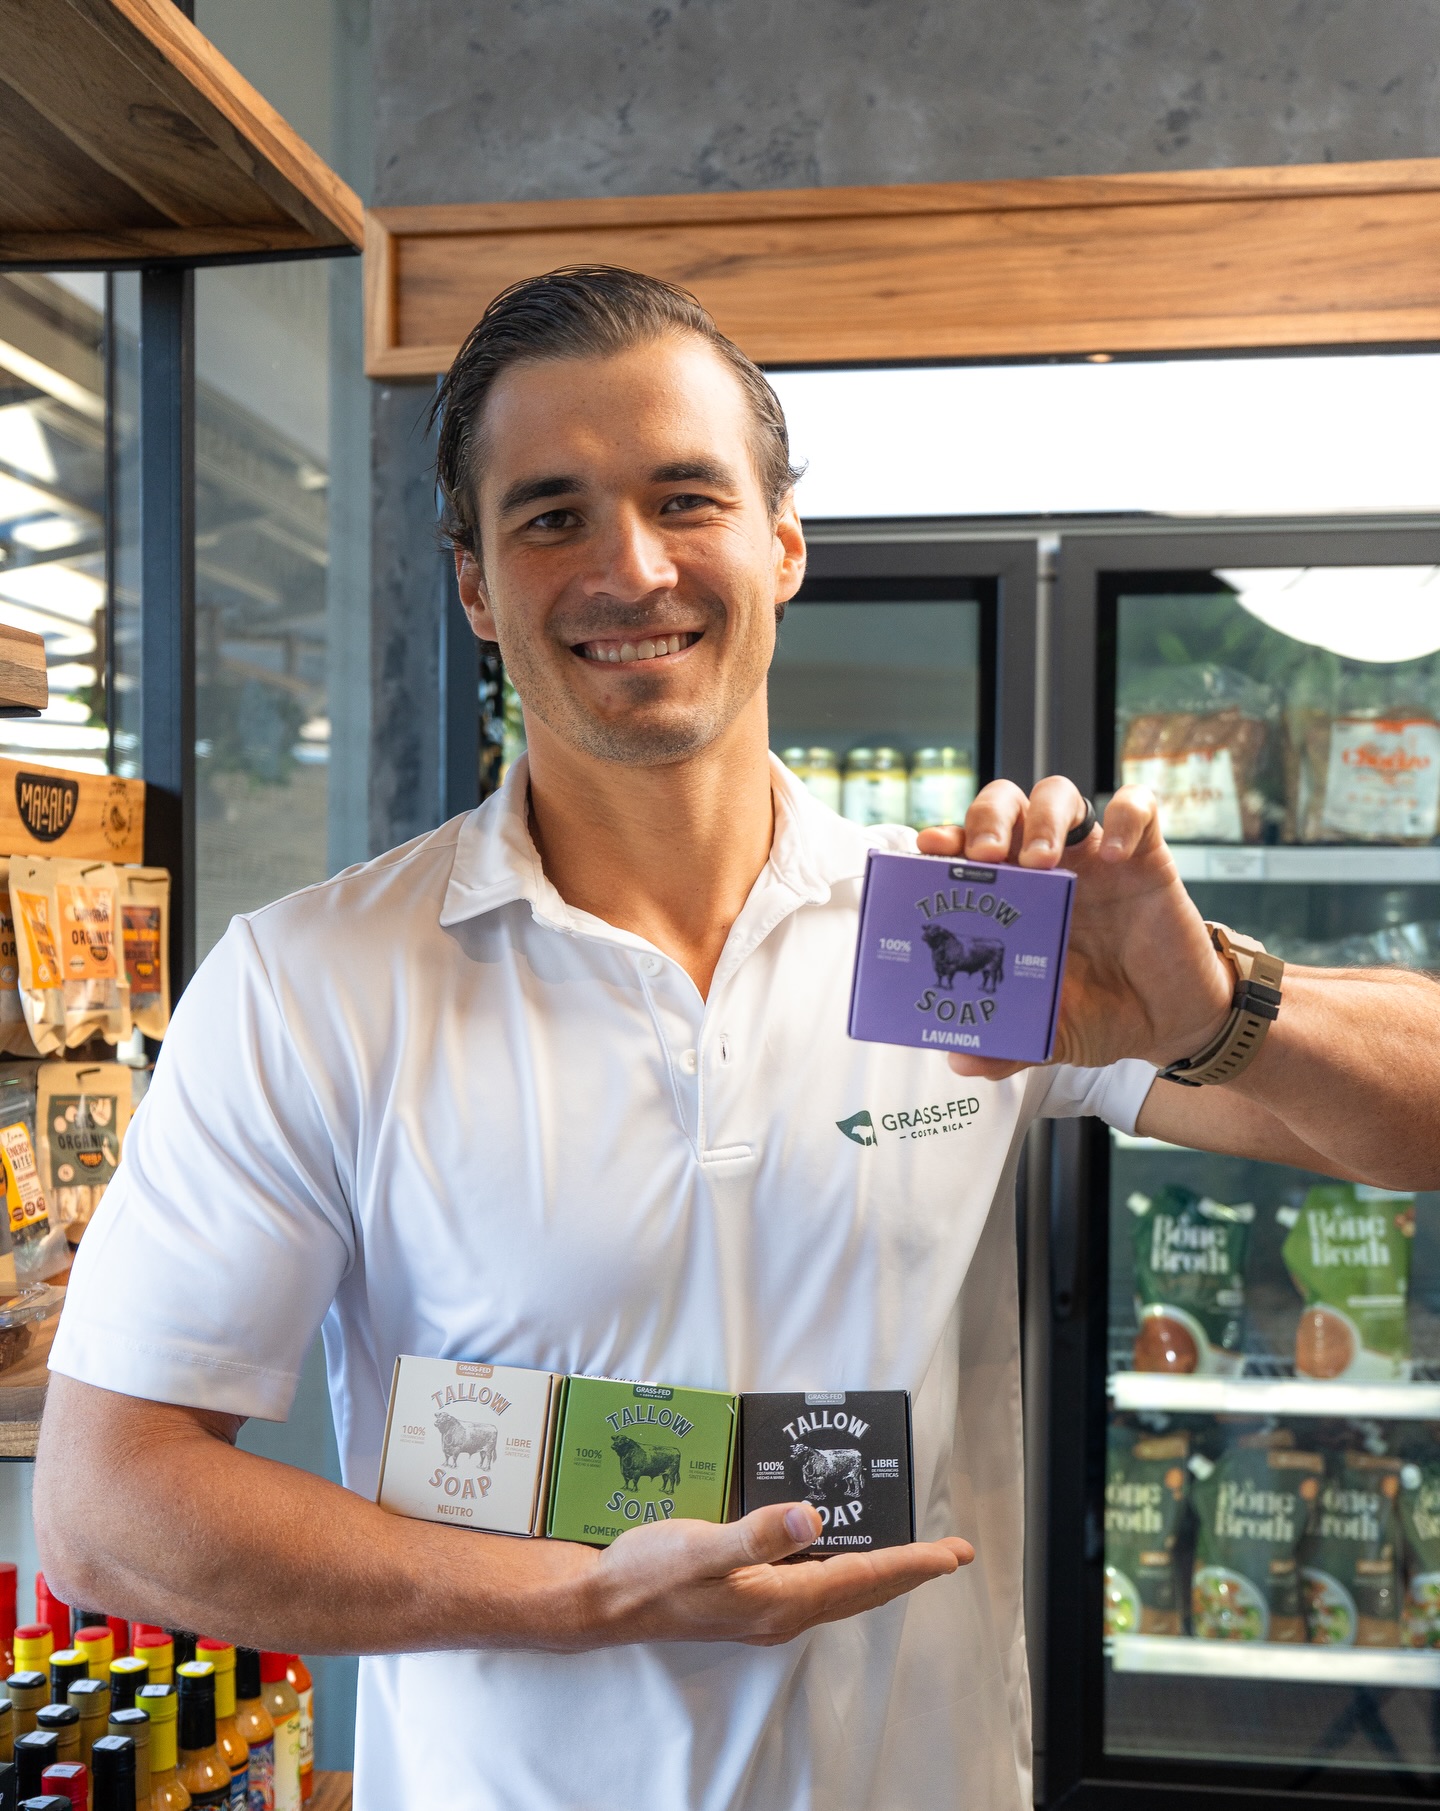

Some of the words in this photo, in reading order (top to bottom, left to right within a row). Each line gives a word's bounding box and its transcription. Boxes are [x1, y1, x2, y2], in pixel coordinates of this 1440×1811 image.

[20, 783, 72, 833] MAKALA
[915, 888, 1022, 929] TALLOW
[879, 938, 912, 953] 100%
[1015, 954, 1048, 968] LIBRE
[915, 988, 997, 1026] SOAP
[922, 1029, 981, 1048] LAVANDA
[881, 1097, 980, 1131] GRASS-FED
[911, 1127, 938, 1139] COSTA
[943, 1123, 964, 1134] RICA
[636, 1386, 671, 1396] GRASS-FED
[431, 1383, 512, 1416] TALLOW
[605, 1405, 694, 1438] TALLOW
[782, 1410, 869, 1441] TALLOW
[402, 1425, 426, 1436] 100%
[505, 1438, 531, 1448] LIBRE
[575, 1448, 602, 1459] 100%
[689, 1460, 717, 1472] LIBRE
[756, 1461, 785, 1471] 100%
[871, 1459, 899, 1468] LIBRE
[429, 1468, 492, 1499] SOAP
[437, 1504, 473, 1517] NEUTRO
[606, 1491, 675, 1523] SOAP
[583, 1525, 624, 1537] ROMERO
[826, 1535, 872, 1545] ACTIVADO
